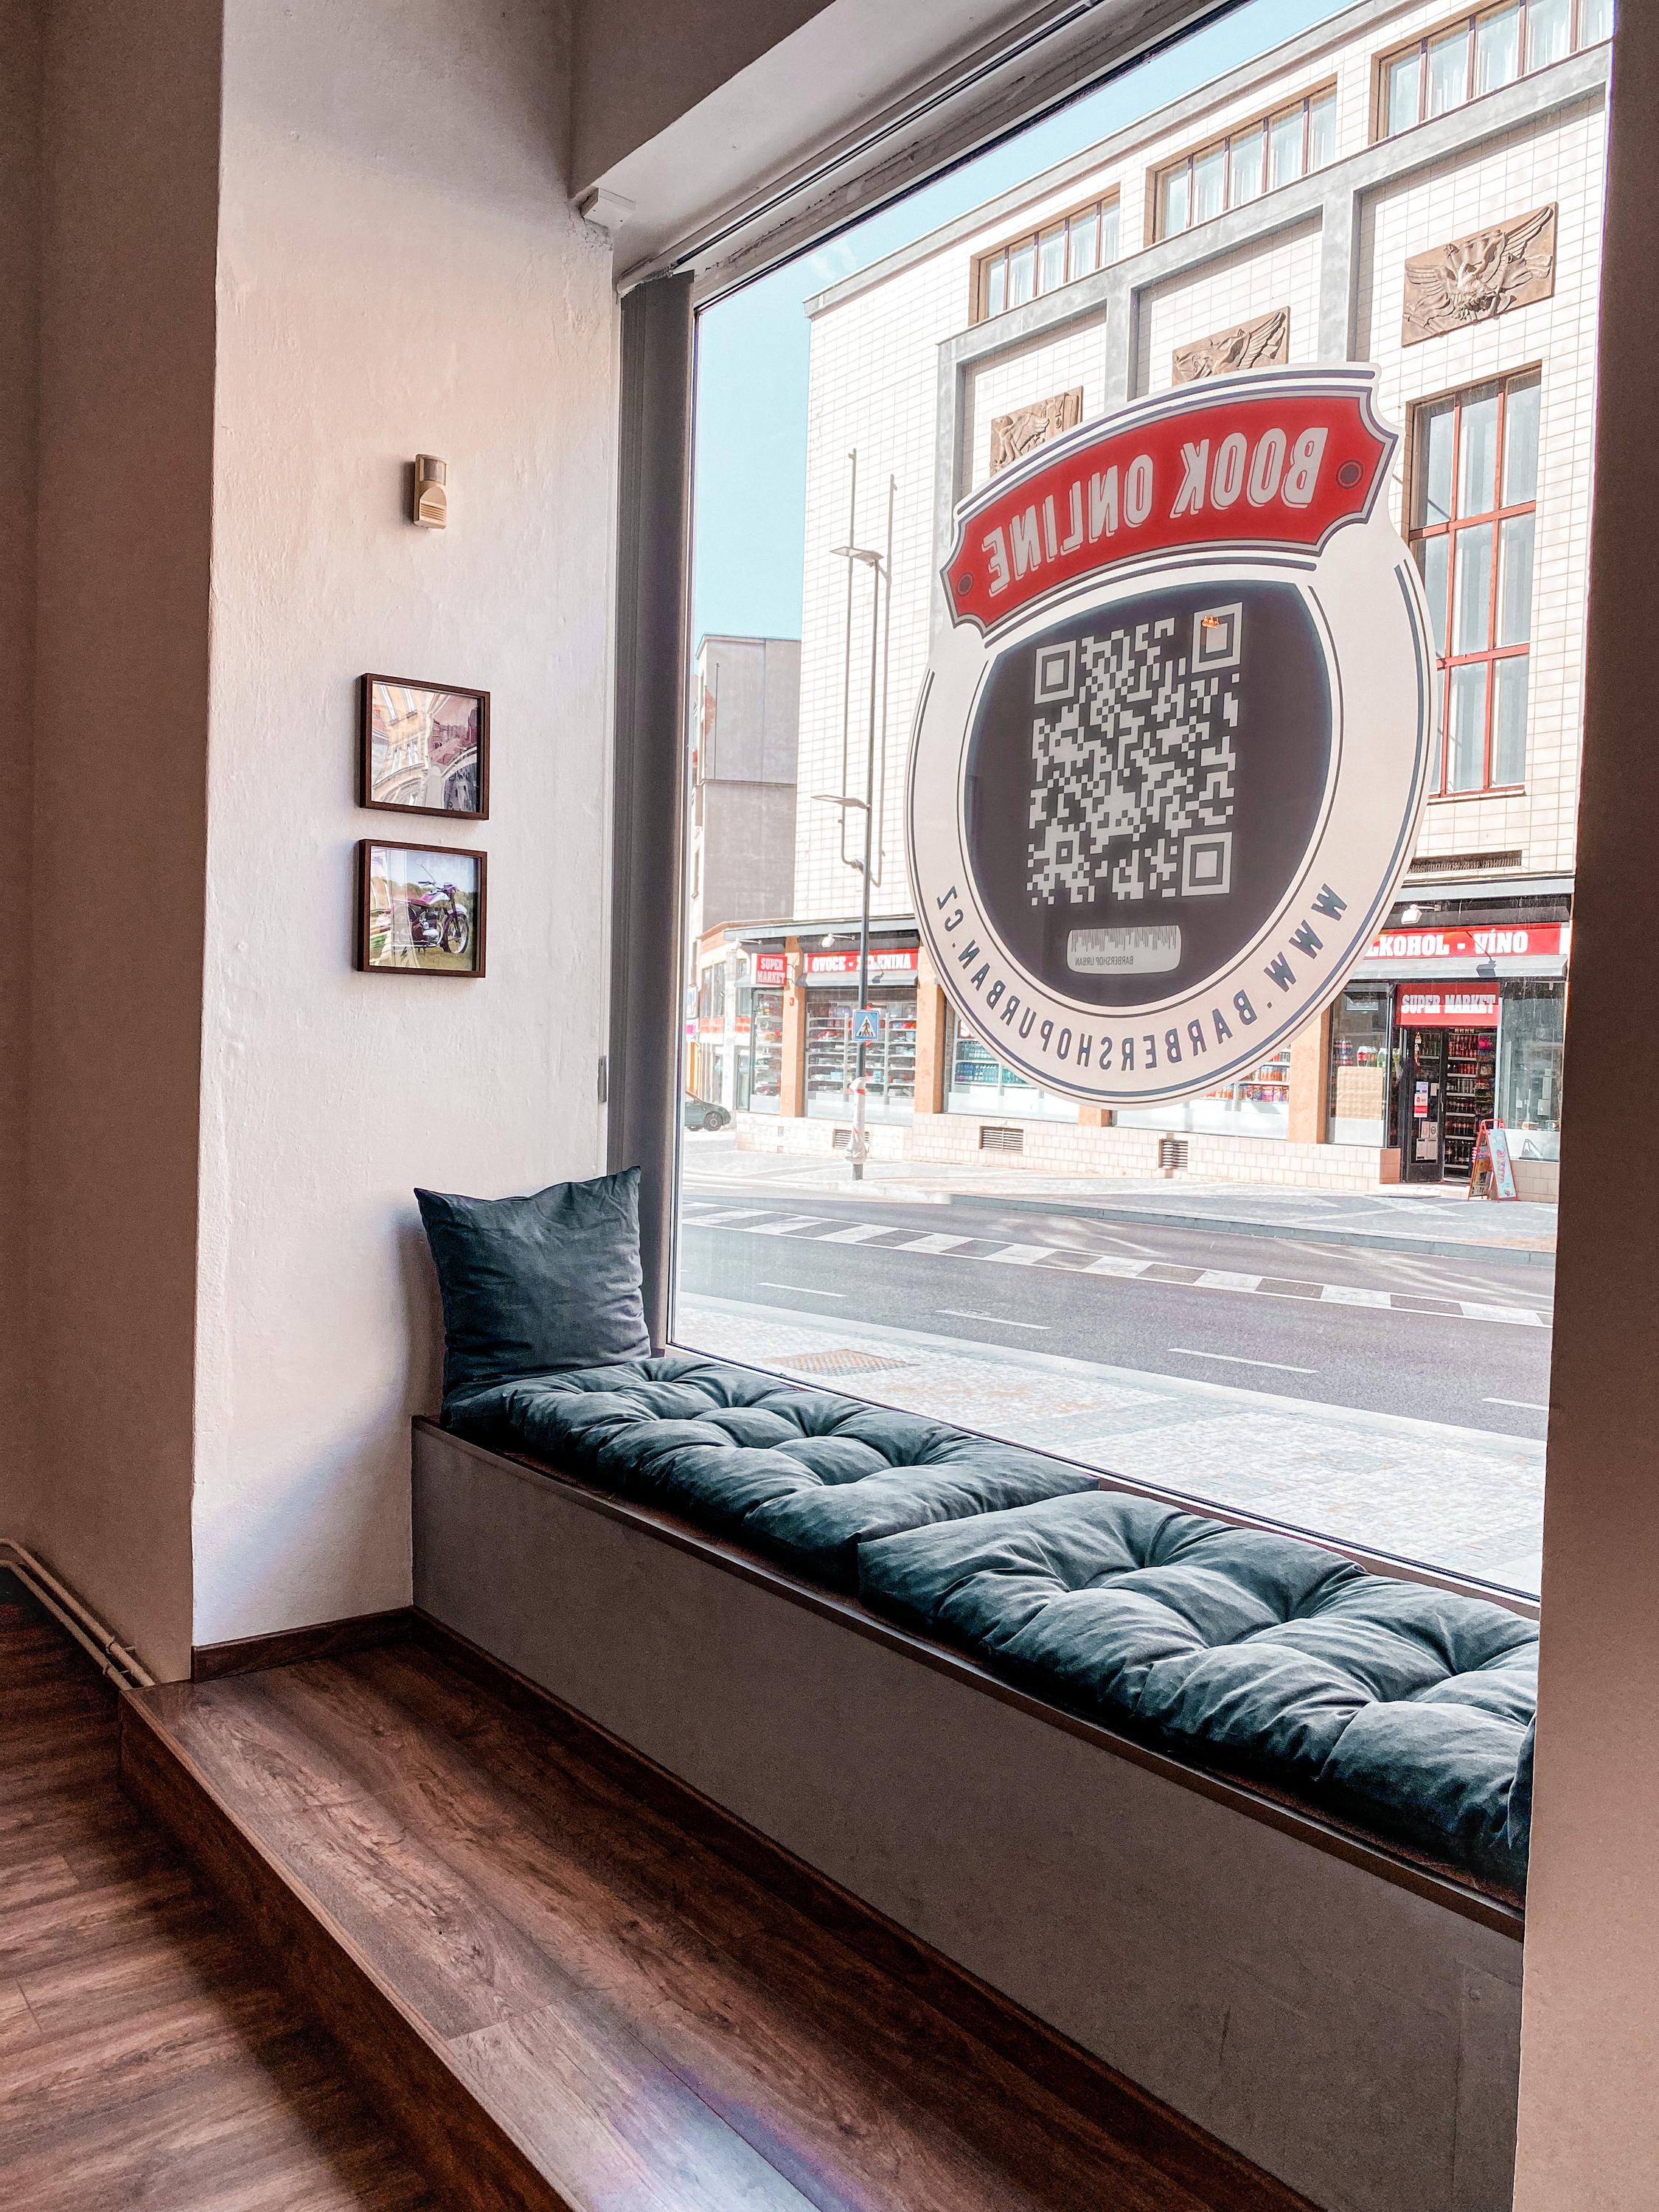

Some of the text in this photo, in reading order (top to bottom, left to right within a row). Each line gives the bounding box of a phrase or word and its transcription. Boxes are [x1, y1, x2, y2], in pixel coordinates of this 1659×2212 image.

[1366, 934, 1450, 957] LKOHOL
[1473, 928, 1528, 954] VÍNO
[760, 957, 784, 970] SUPER
[813, 956, 846, 972] OVOCE
[757, 970, 786, 984] MARKET
[1401, 994, 1496, 1015] SUPER MARKET
